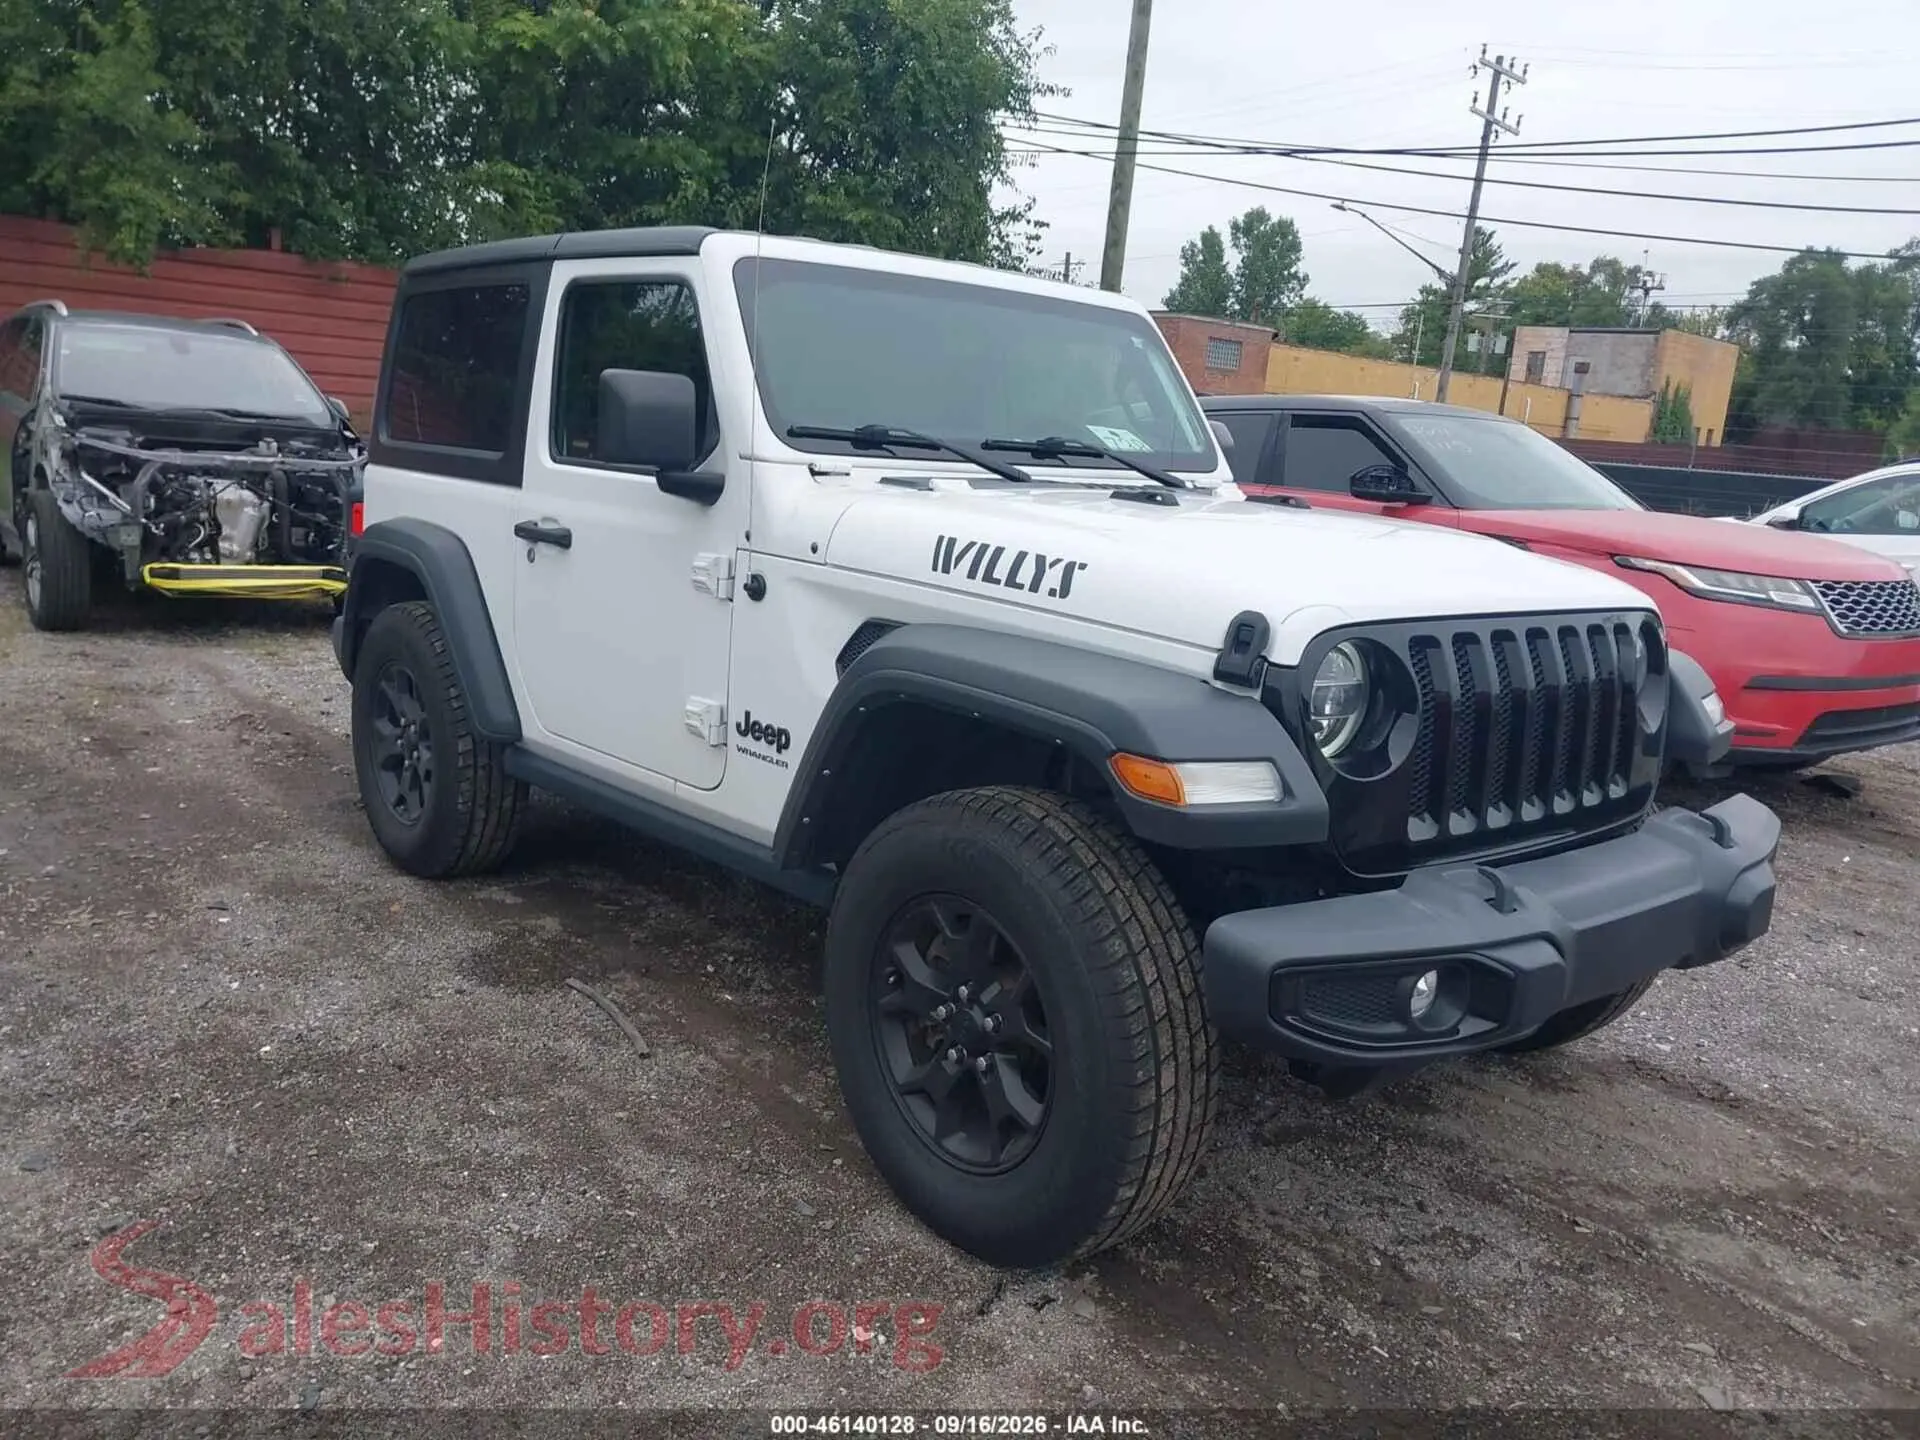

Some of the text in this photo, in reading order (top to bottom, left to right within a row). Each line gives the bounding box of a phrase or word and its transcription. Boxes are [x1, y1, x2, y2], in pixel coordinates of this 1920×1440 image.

[932, 535, 1088, 599] WILLYS
[736, 709, 791, 754] Jeep
[736, 743, 789, 769] WRANGLER
